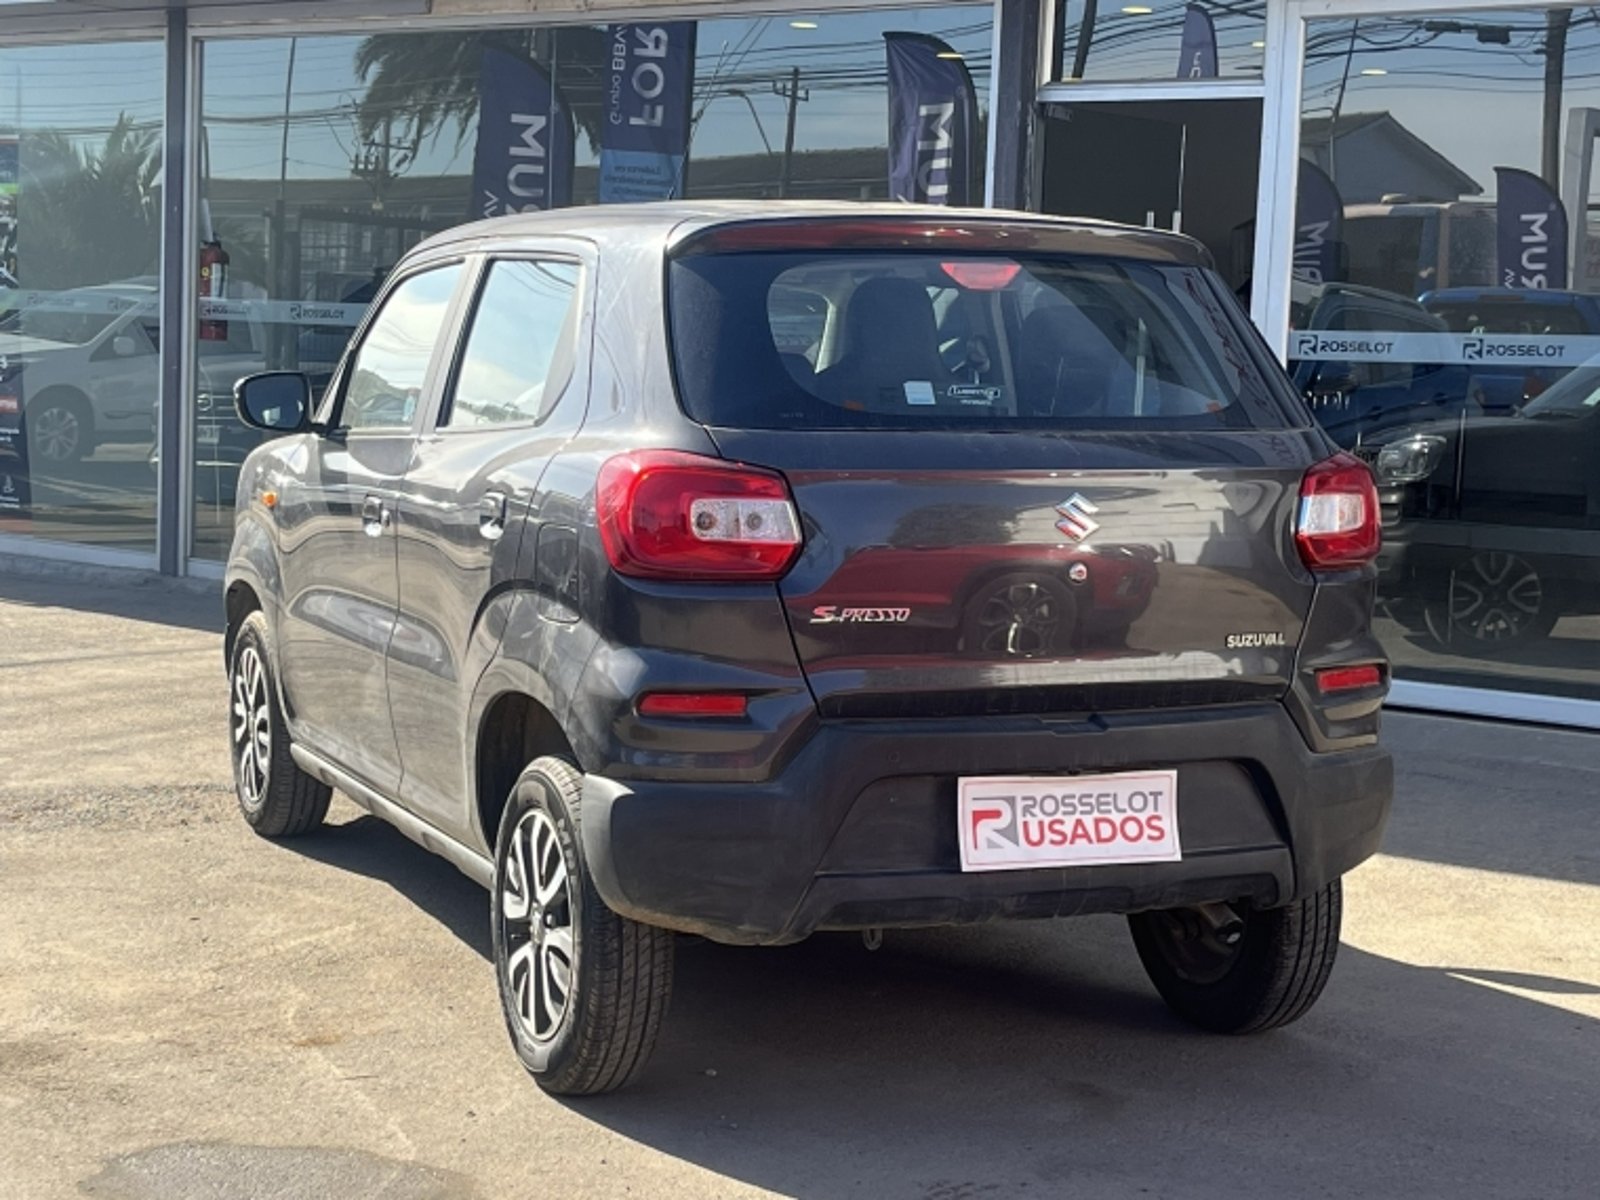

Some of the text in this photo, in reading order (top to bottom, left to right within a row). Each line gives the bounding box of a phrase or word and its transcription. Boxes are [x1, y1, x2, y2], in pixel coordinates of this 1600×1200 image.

[1320, 340, 1394, 353] ROSSELOT
[1486, 344, 1565, 357] ROSSELOT
[1226, 632, 1285, 649] SUZUVAL
[1021, 791, 1163, 818] ROSSELOT
[1022, 815, 1165, 847] USADOS
